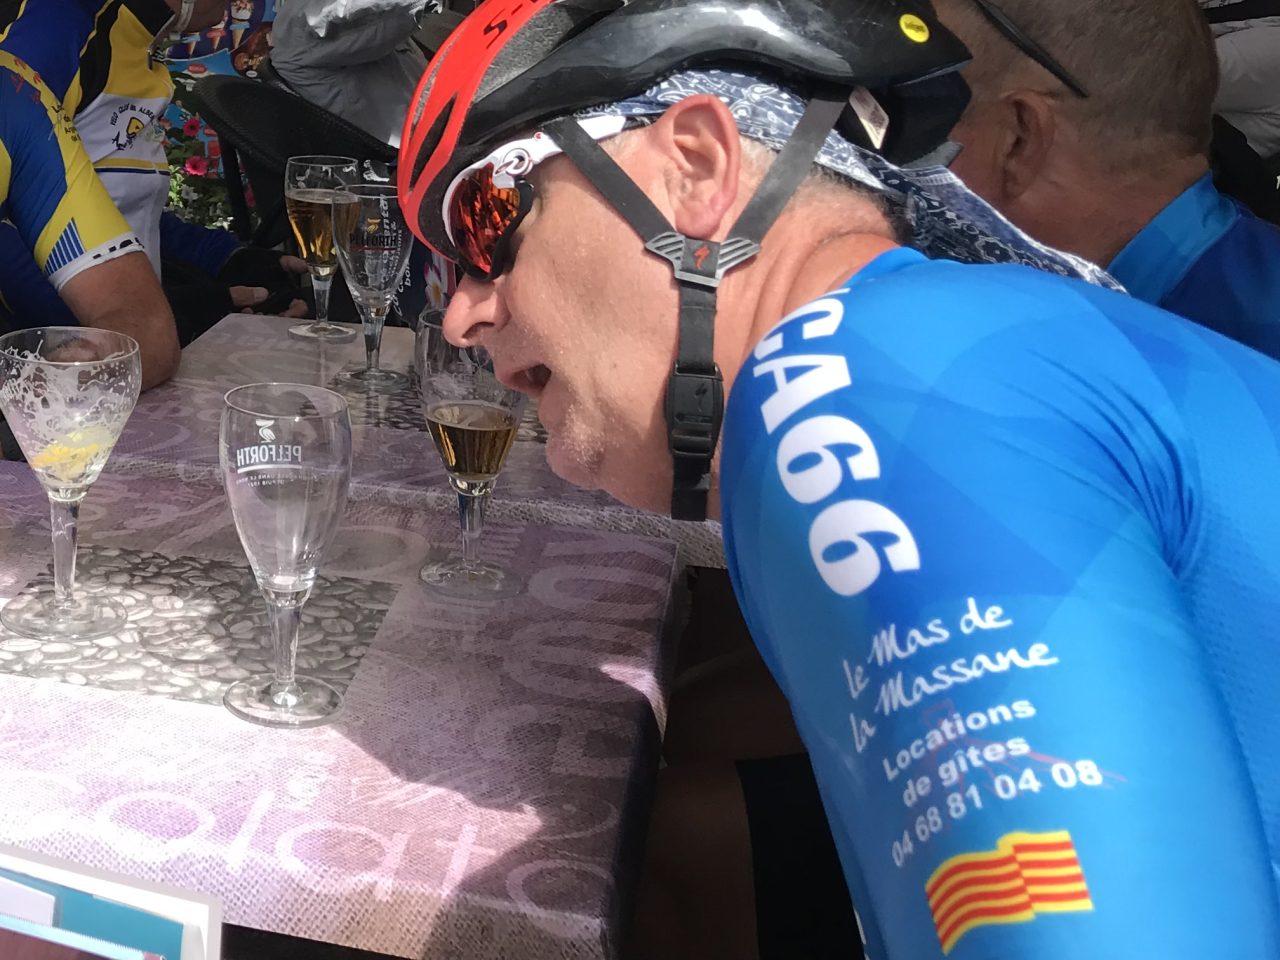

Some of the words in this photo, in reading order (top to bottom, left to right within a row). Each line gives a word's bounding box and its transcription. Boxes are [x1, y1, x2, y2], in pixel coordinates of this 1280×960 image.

[752, 287, 921, 597] CA66
[867, 617, 950, 667] Mas
[960, 596, 1013, 634] de
[874, 642, 1060, 716] Massane
[882, 699, 1037, 781] Locations
[903, 775, 931, 807] de
[938, 735, 1031, 786] gîtes
[892, 830, 914, 868] 04
[915, 806, 943, 842] 68
[946, 784, 983, 819] 81
[993, 767, 1043, 800] 04
[1051, 759, 1103, 789] 08
